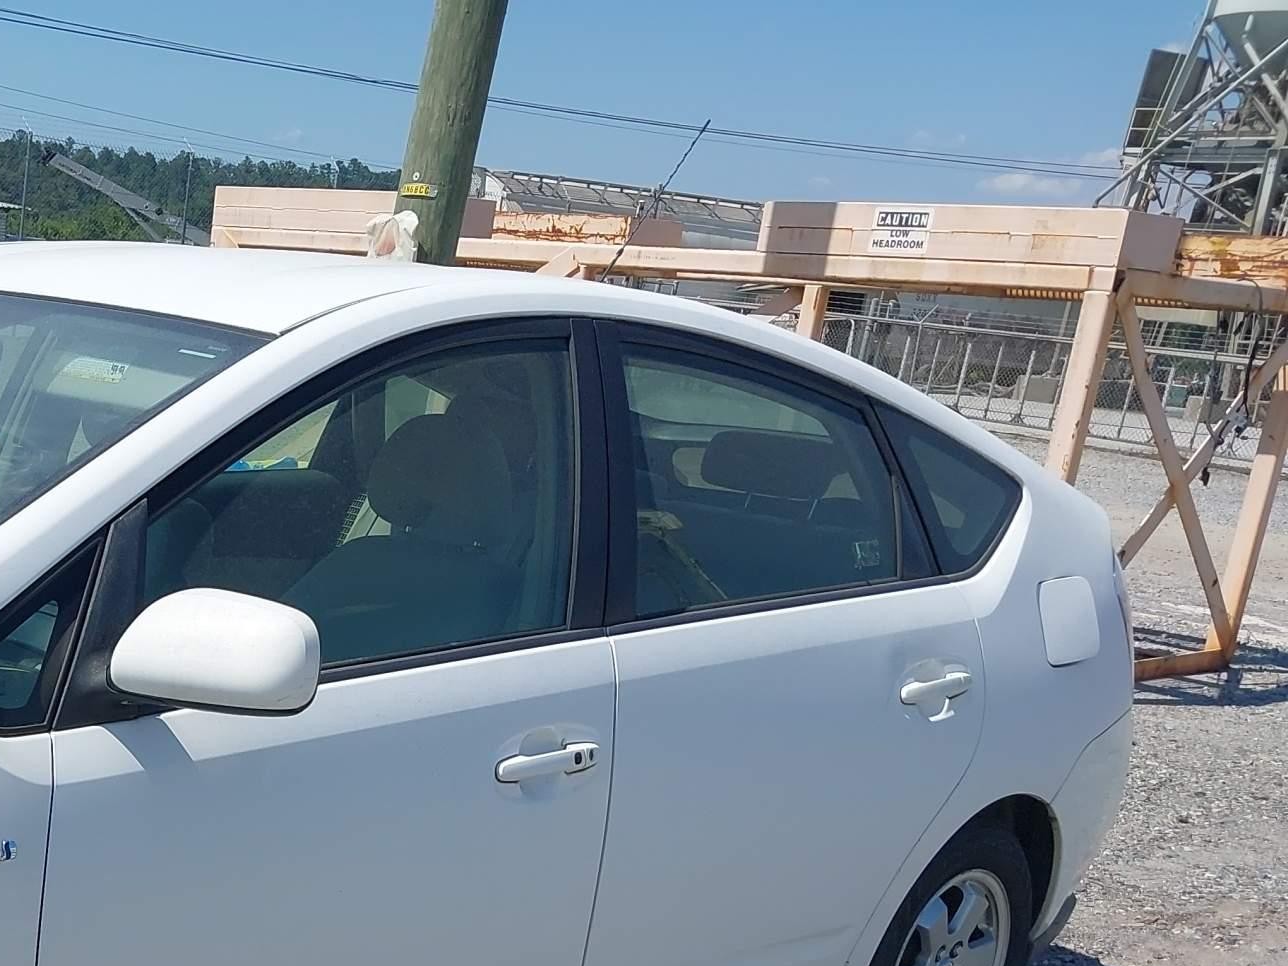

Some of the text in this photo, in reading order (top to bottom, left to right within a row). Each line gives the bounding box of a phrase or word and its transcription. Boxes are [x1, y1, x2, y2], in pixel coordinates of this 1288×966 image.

[877, 212, 929, 226] CAUTION
[890, 229, 910, 238] LOW
[872, 239, 923, 249] HEADROOM
